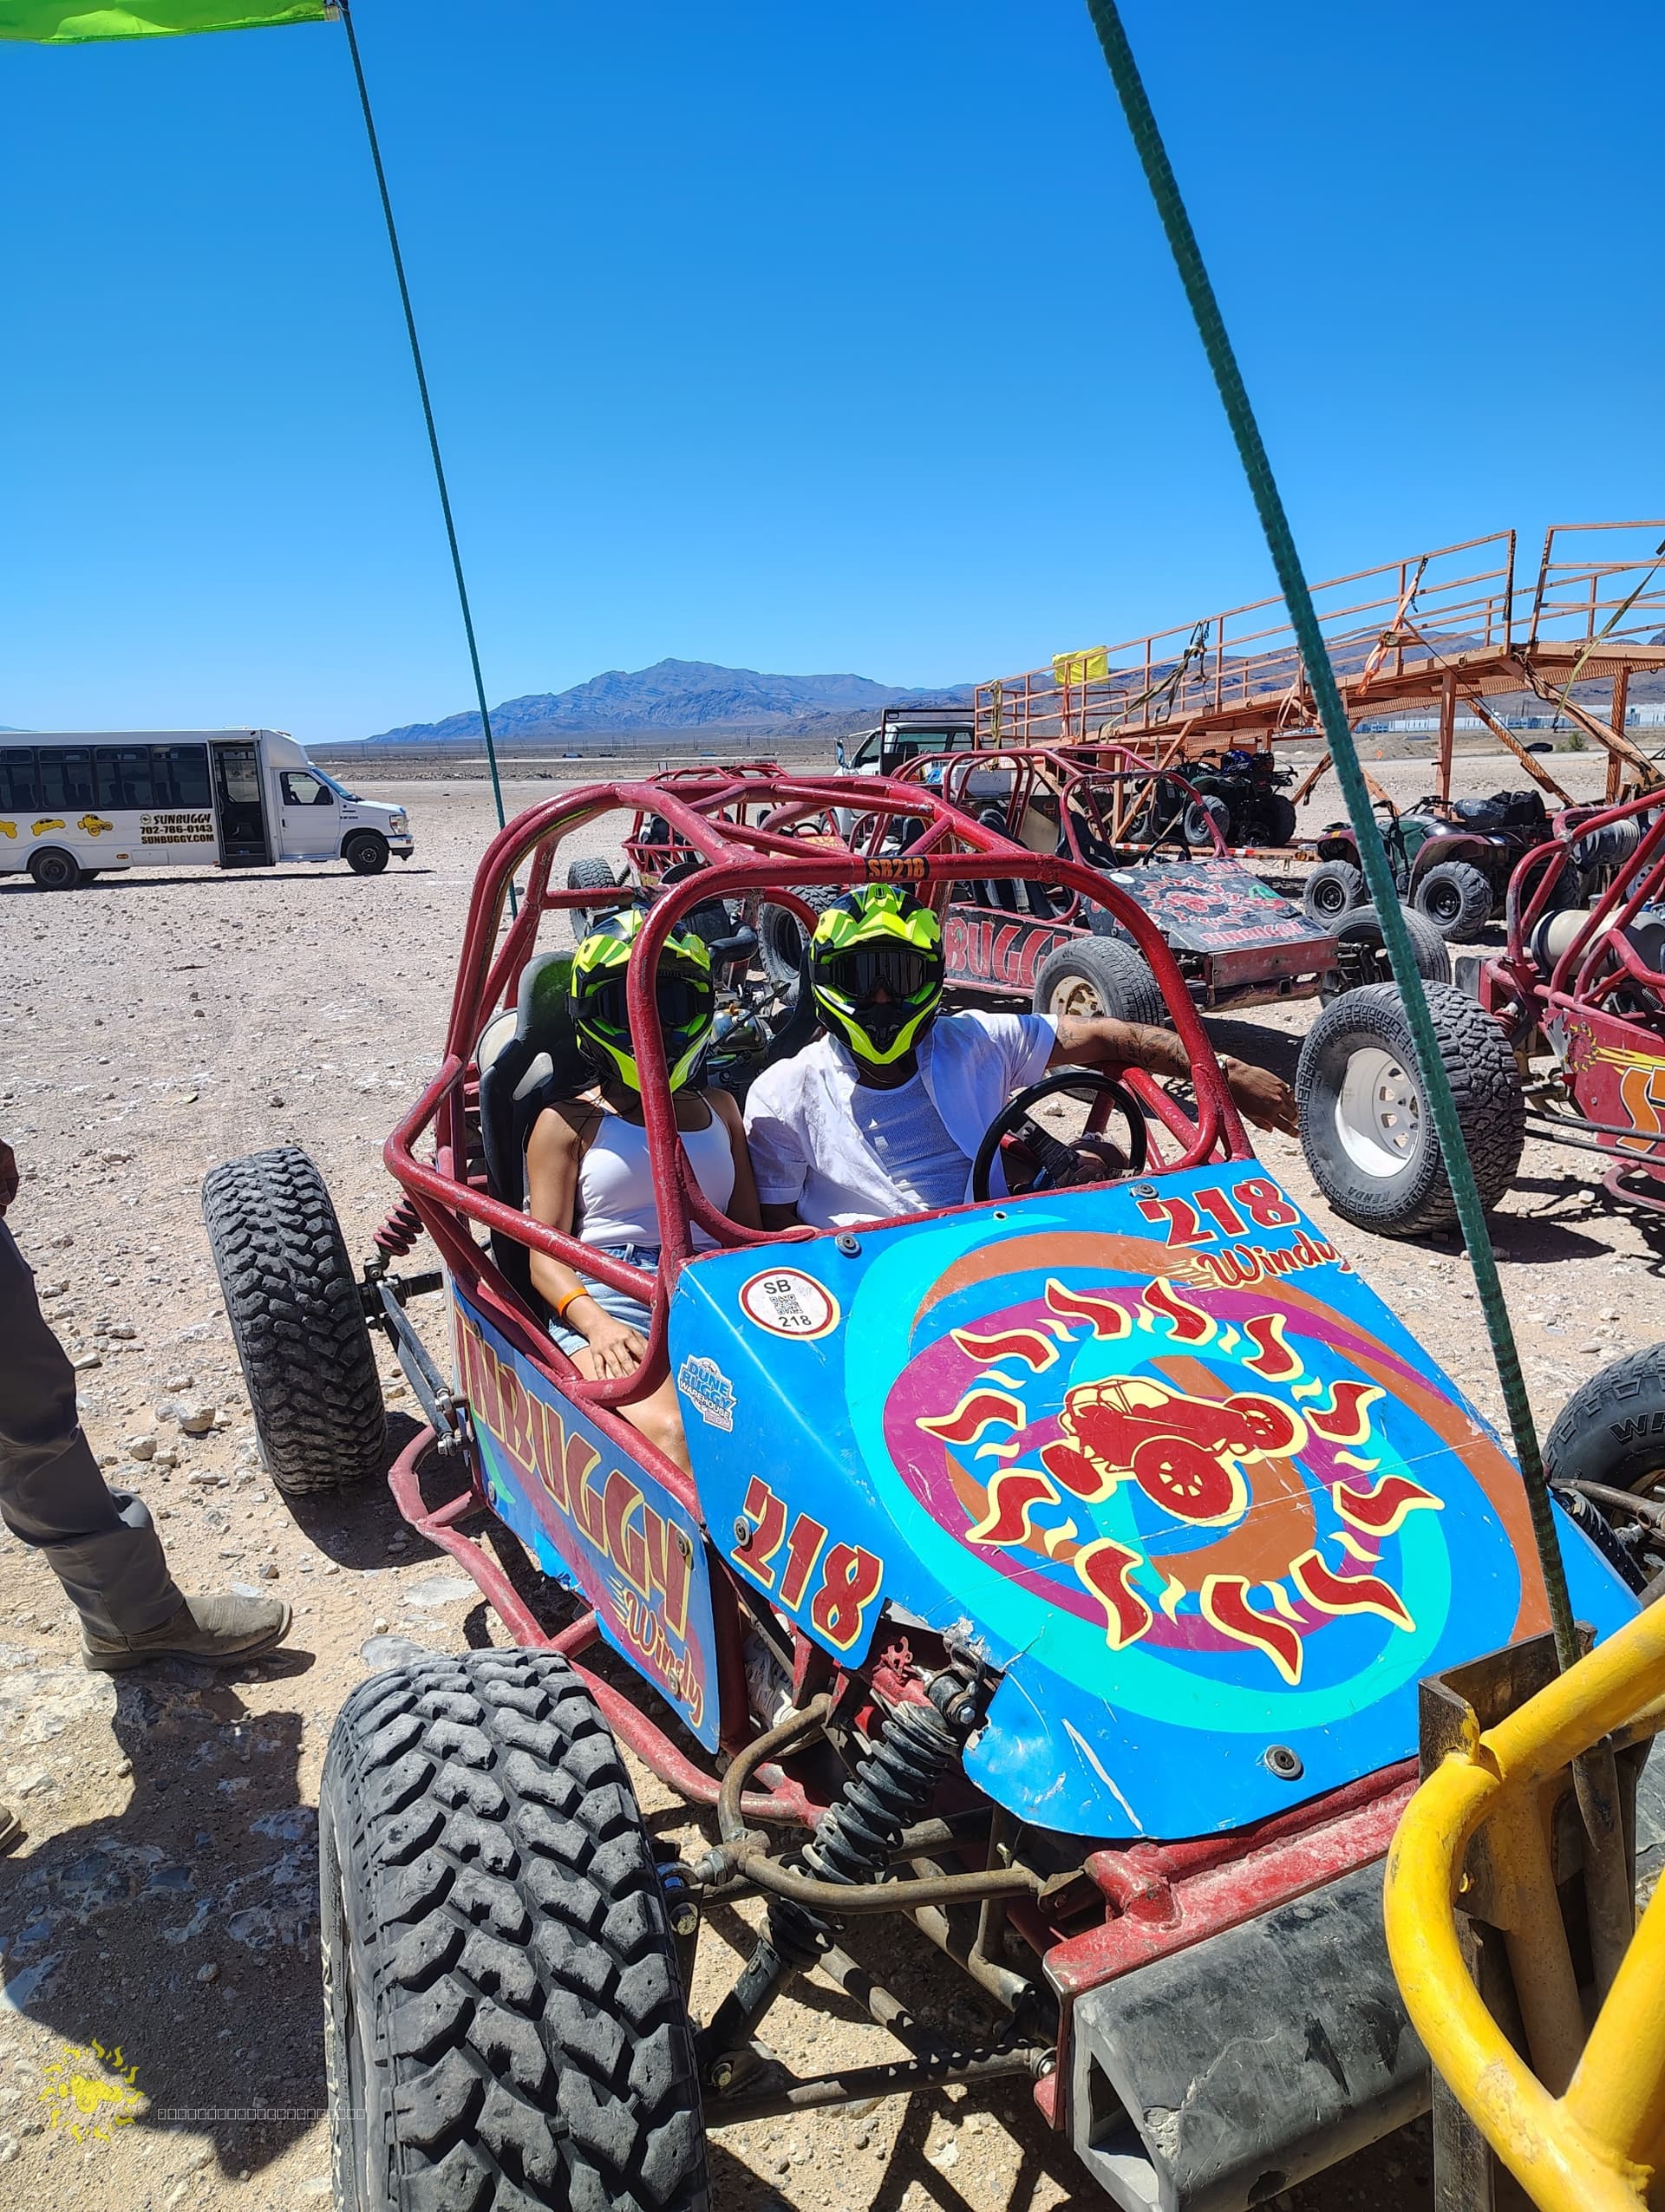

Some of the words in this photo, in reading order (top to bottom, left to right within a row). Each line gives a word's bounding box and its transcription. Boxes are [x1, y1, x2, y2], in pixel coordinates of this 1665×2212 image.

[140, 825, 213, 834] 702-786-0143
[153, 813, 212, 825] SUNBUGGY
[141, 834, 214, 845] SUNBUGGY.COM
[868, 857, 925, 878] SB218
[944, 917, 1084, 989] BUGG
[1136, 1178, 1301, 1250] 218
[1192, 1230, 1355, 1289] Windy
[763, 1279, 792, 1295] SB
[779, 1315, 812, 1328] 218
[682, 1368, 733, 1409] BUGGY
[689, 1361, 730, 1397] DUNE
[680, 1380, 730, 1420] WAREHOUSE
[730, 1474, 885, 1652] 218
[623, 1586, 704, 1728] Windy
